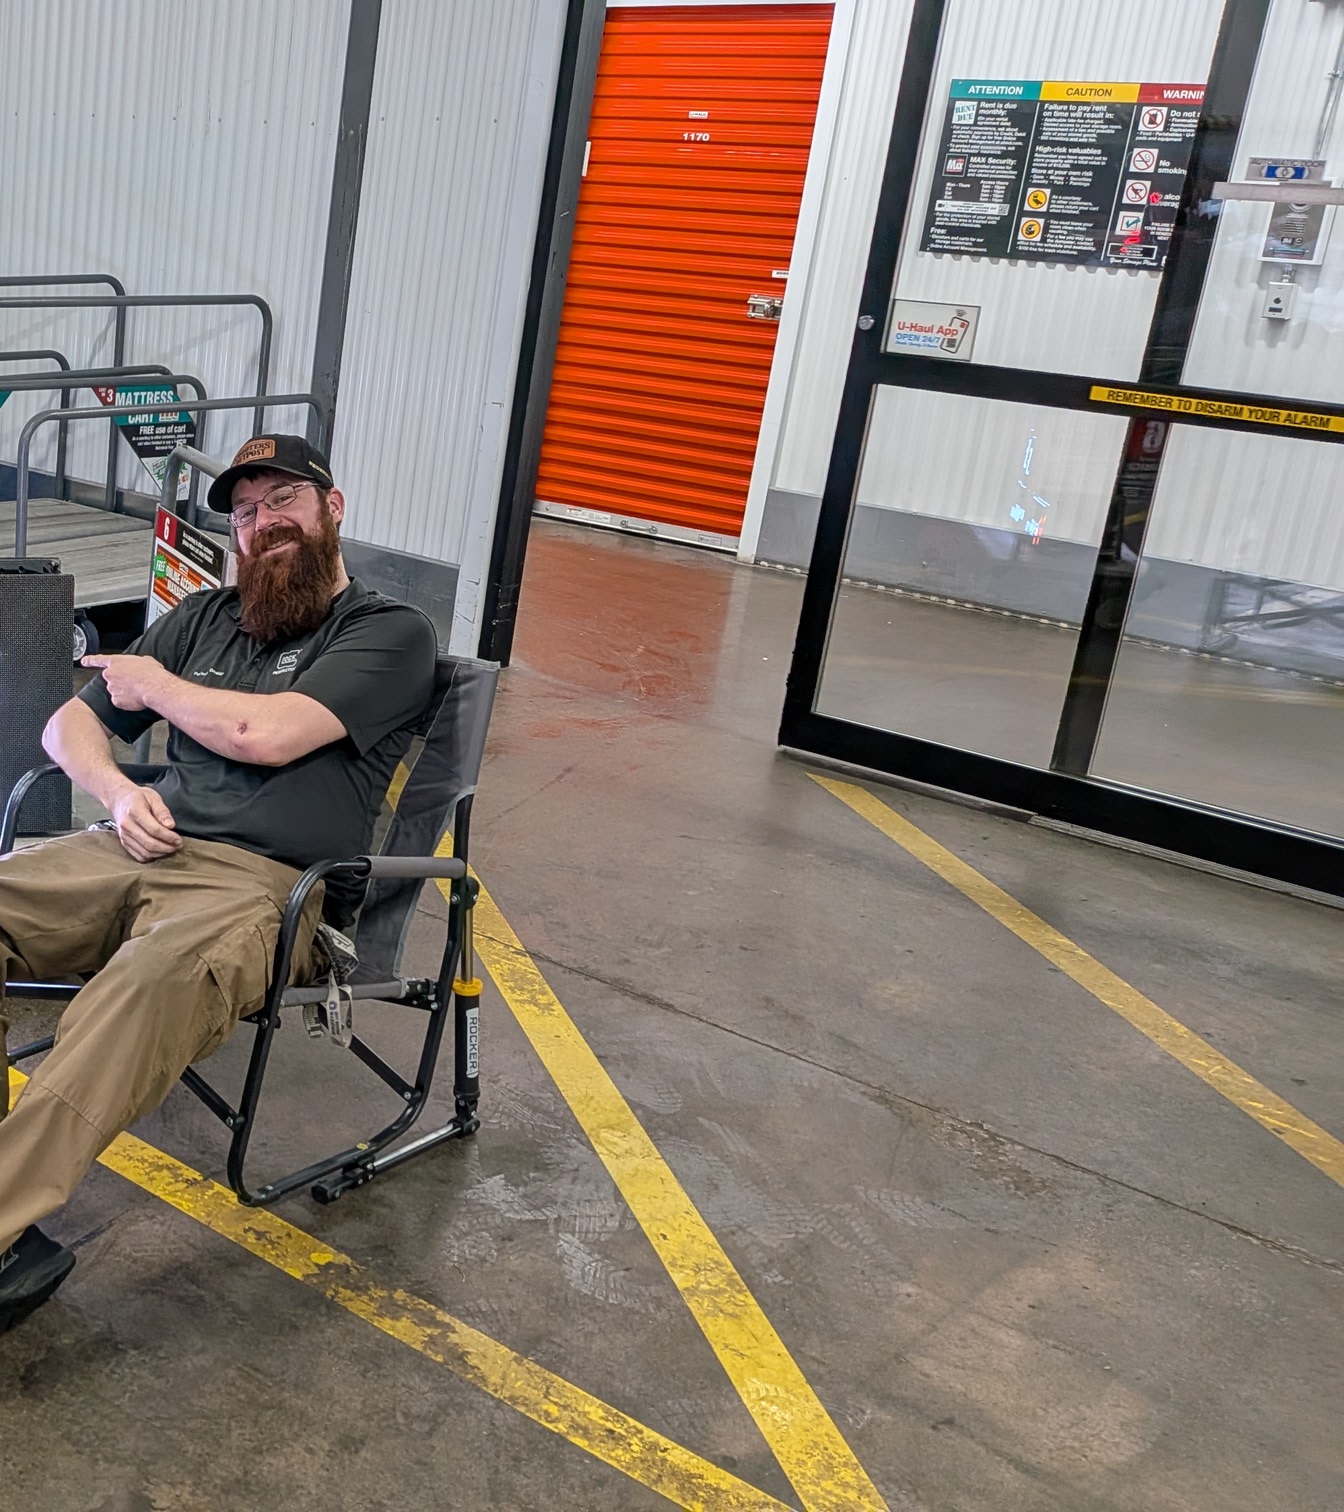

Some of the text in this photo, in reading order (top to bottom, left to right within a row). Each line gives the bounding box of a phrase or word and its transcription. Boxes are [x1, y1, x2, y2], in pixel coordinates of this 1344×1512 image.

[969, 86, 1023, 95] ATTENTION
[1066, 88, 1113, 97] CAUTION
[955, 104, 976, 113] RENT
[1044, 103, 1108, 113] Failure to pay rent
[957, 113, 974, 121] DUE
[683, 132, 710, 142] 1170
[1036, 146, 1102, 155] High-risk valuables
[970, 156, 1017, 165] MAX Security:
[897, 321, 959, 337] U-Haul App
[896, 332, 941, 343] OPEN 24/7
[107, 388, 114, 403] 3
[115, 390, 174, 407] MATTRESS
[1107, 389, 1332, 429] REMEMBER TO DISARM YOUR ALARM
[139, 424, 187, 435] FREE use of cart
[163, 516, 171, 541] 6
[156, 559, 166, 572] FREE
[166, 564, 181, 585] NLINE
[469, 1016, 478, 1069] ROCKER
